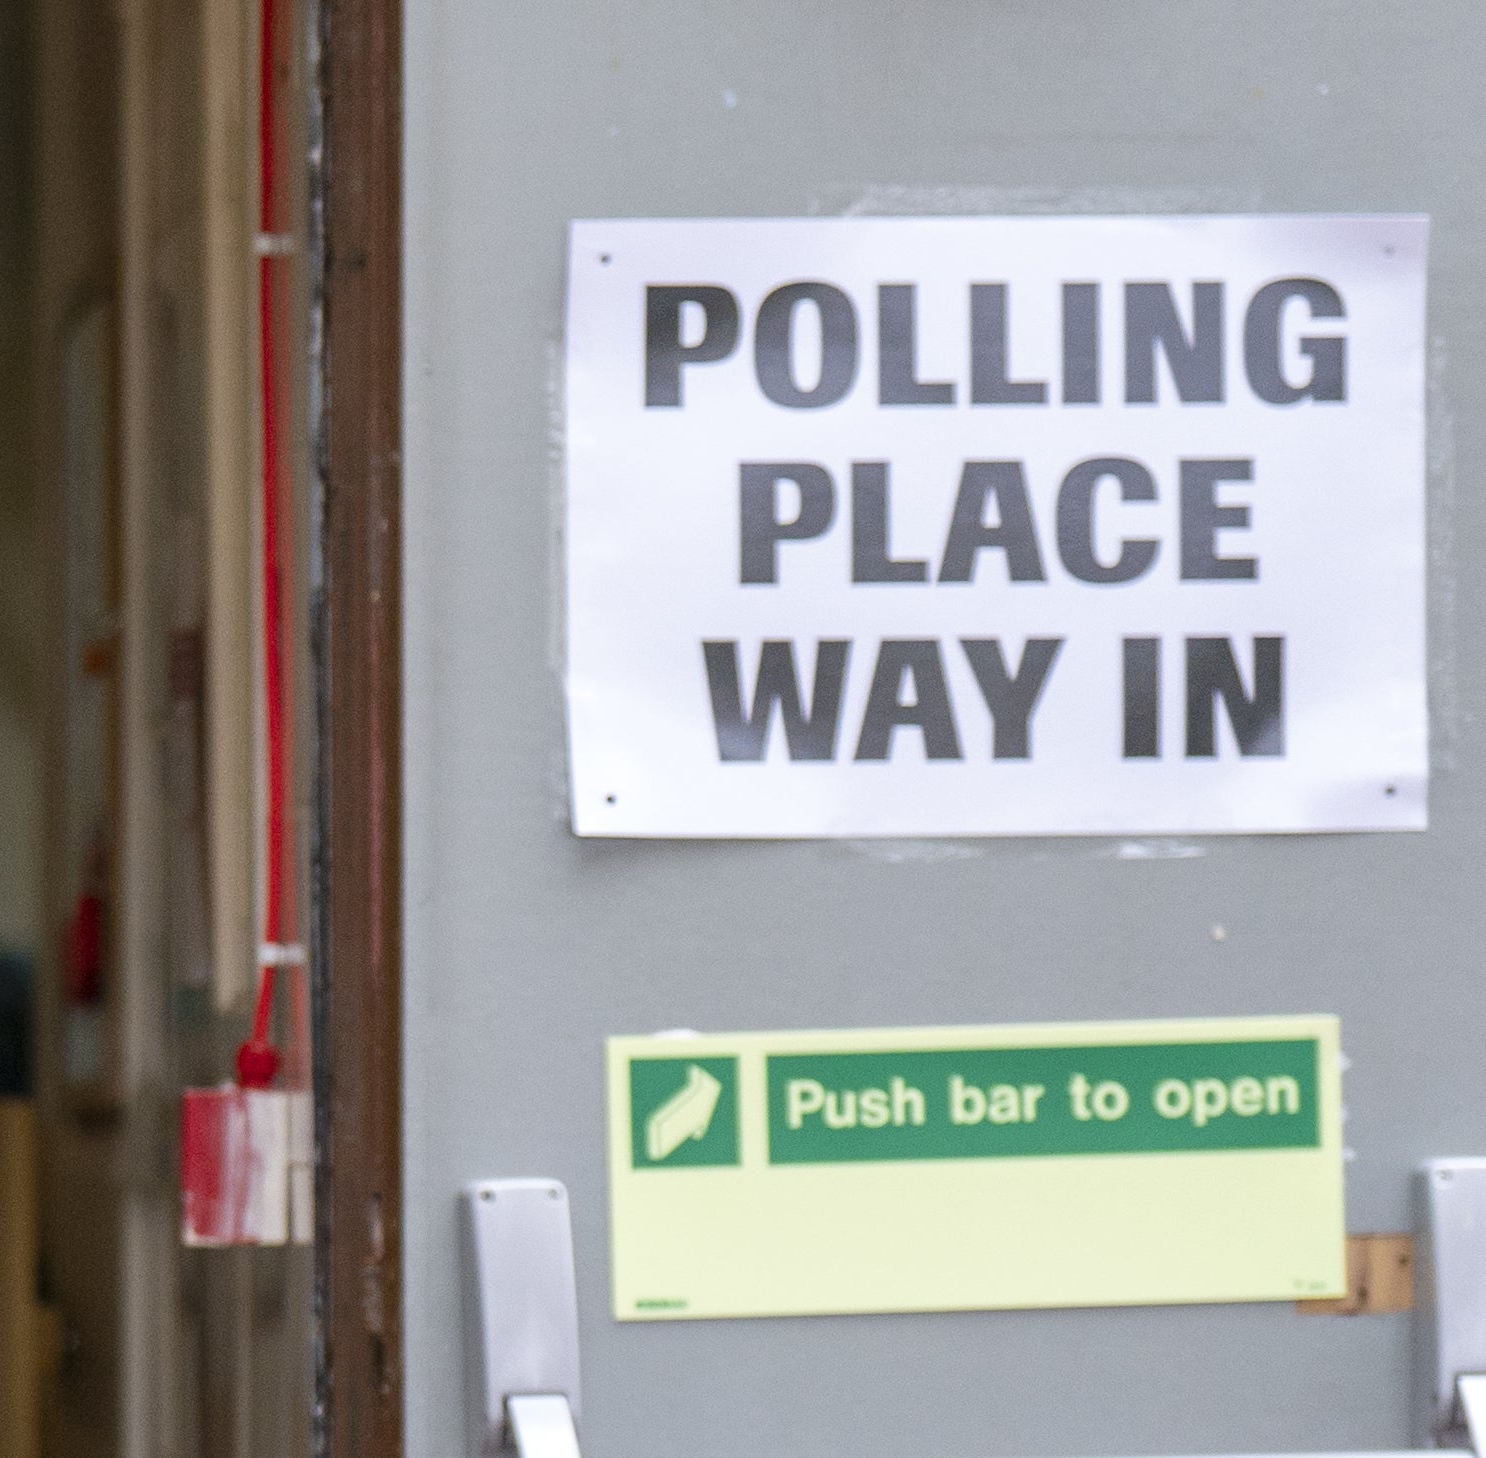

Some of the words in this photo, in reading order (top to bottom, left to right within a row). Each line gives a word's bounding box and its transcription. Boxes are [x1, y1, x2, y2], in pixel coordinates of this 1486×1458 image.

[644, 277, 1349, 408] POLLING
[740, 457, 1258, 585] PLACE
[701, 635, 1065, 763] WAY
[1122, 634, 1286, 760] IN
[786, 1077, 925, 1130] Push
[949, 1075, 1044, 1125] bar
[1069, 1074, 1129, 1121] to
[1153, 1075, 1300, 1127] open
